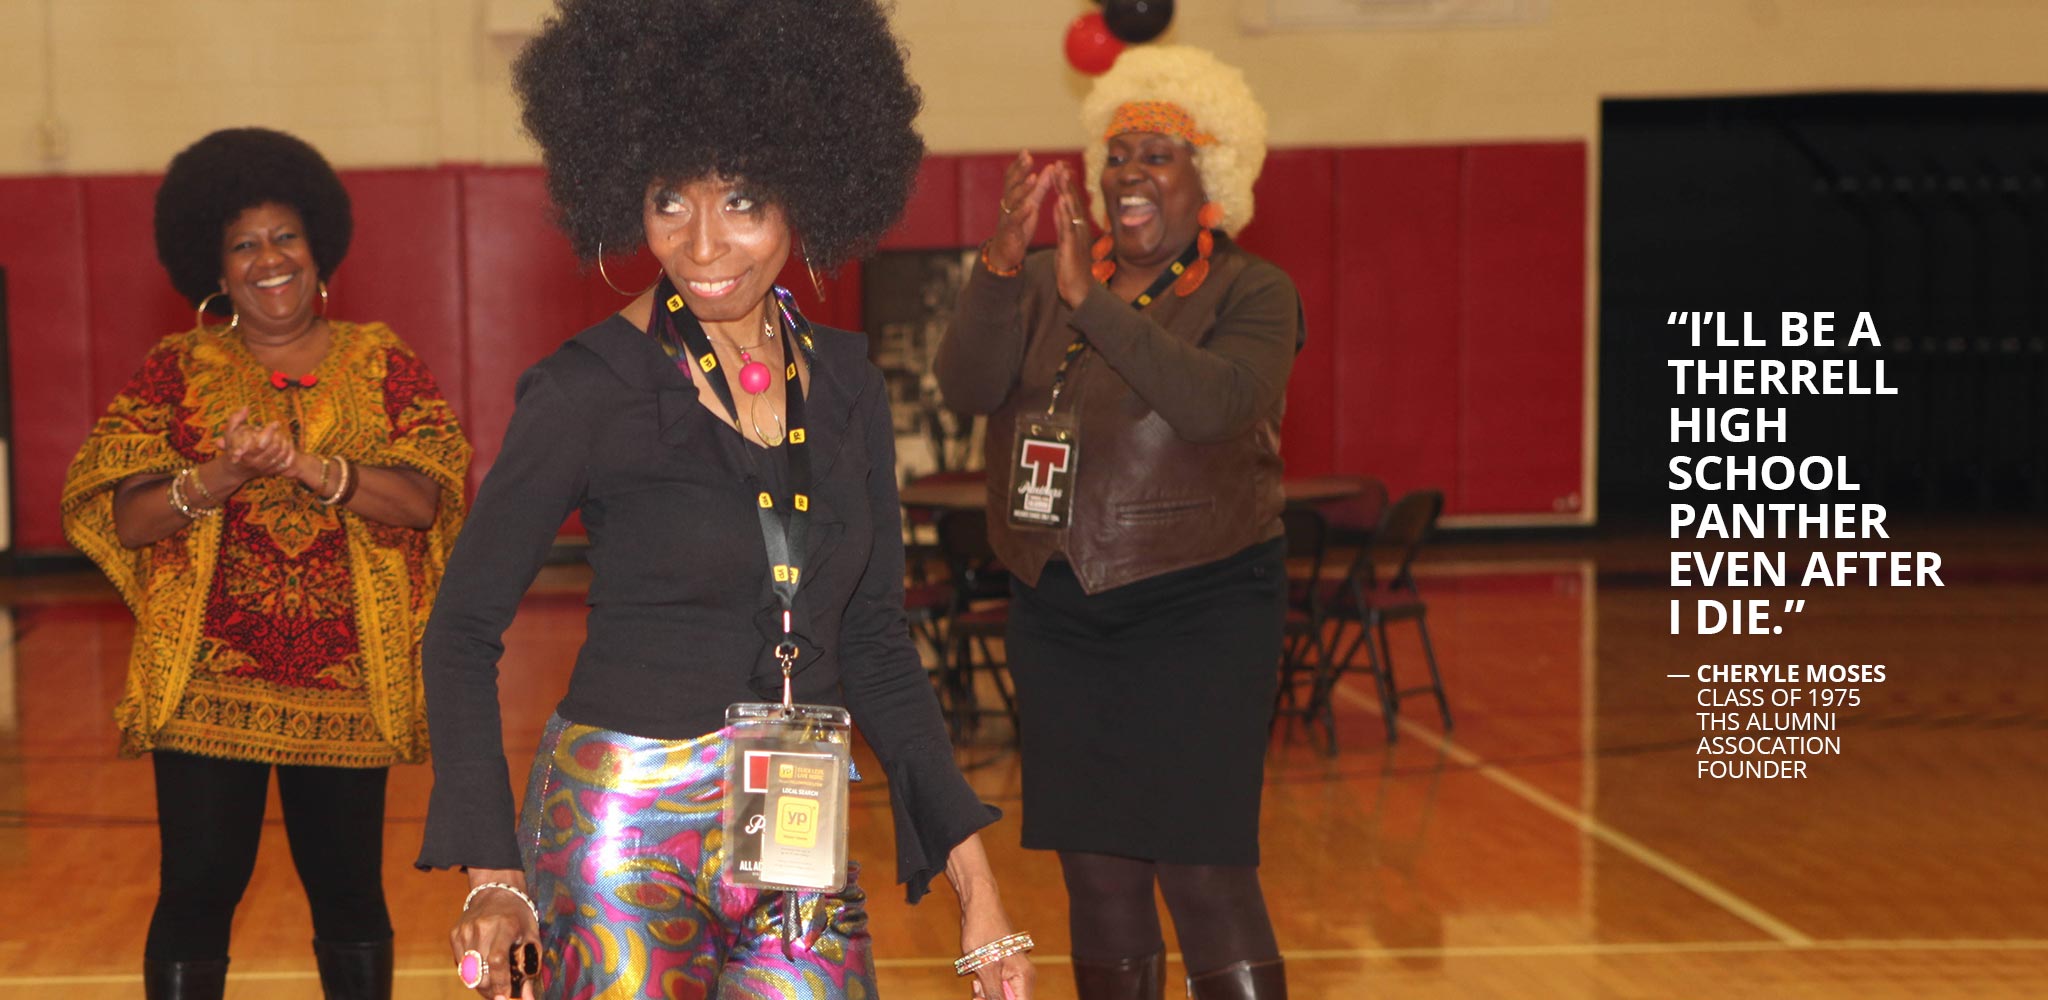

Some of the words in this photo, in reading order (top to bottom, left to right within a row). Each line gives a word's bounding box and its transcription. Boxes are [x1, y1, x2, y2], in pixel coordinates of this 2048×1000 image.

[1021, 439, 1070, 512] T
[782, 787, 799, 795] LOCAL
[788, 811, 808, 826] yp
[739, 861, 753, 871] ALL
